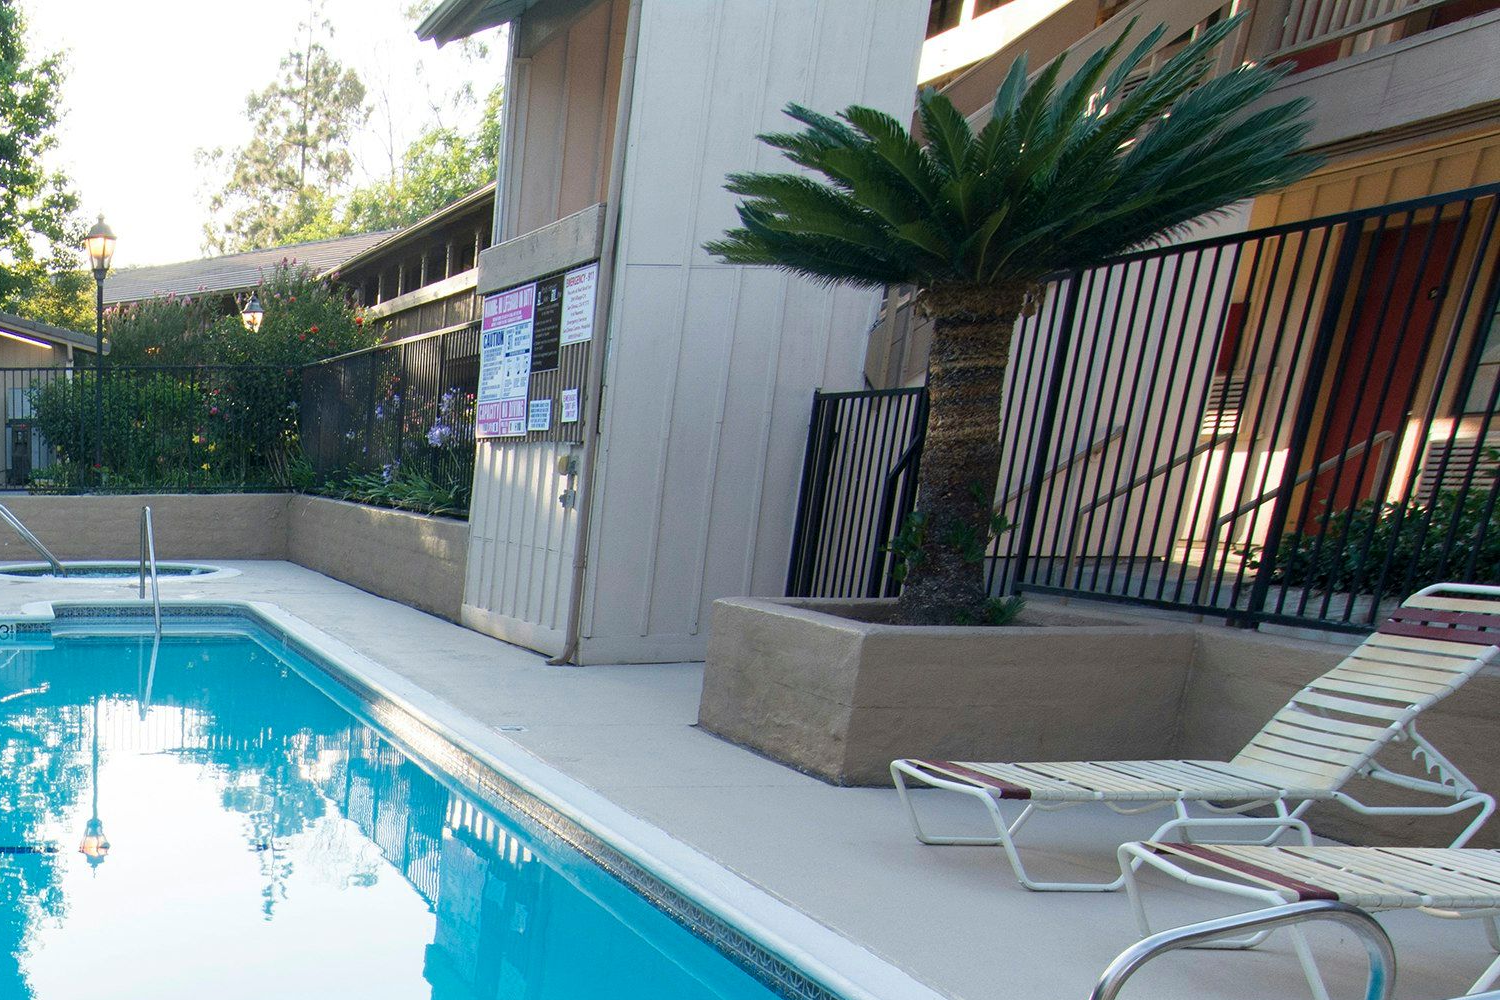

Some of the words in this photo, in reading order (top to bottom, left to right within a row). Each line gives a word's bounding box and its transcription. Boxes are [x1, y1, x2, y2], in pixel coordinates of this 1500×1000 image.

[566, 274, 586, 288] EMERGENCY
[484, 331, 504, 349] CAUTION
[479, 402, 500, 420] CAPACITY
